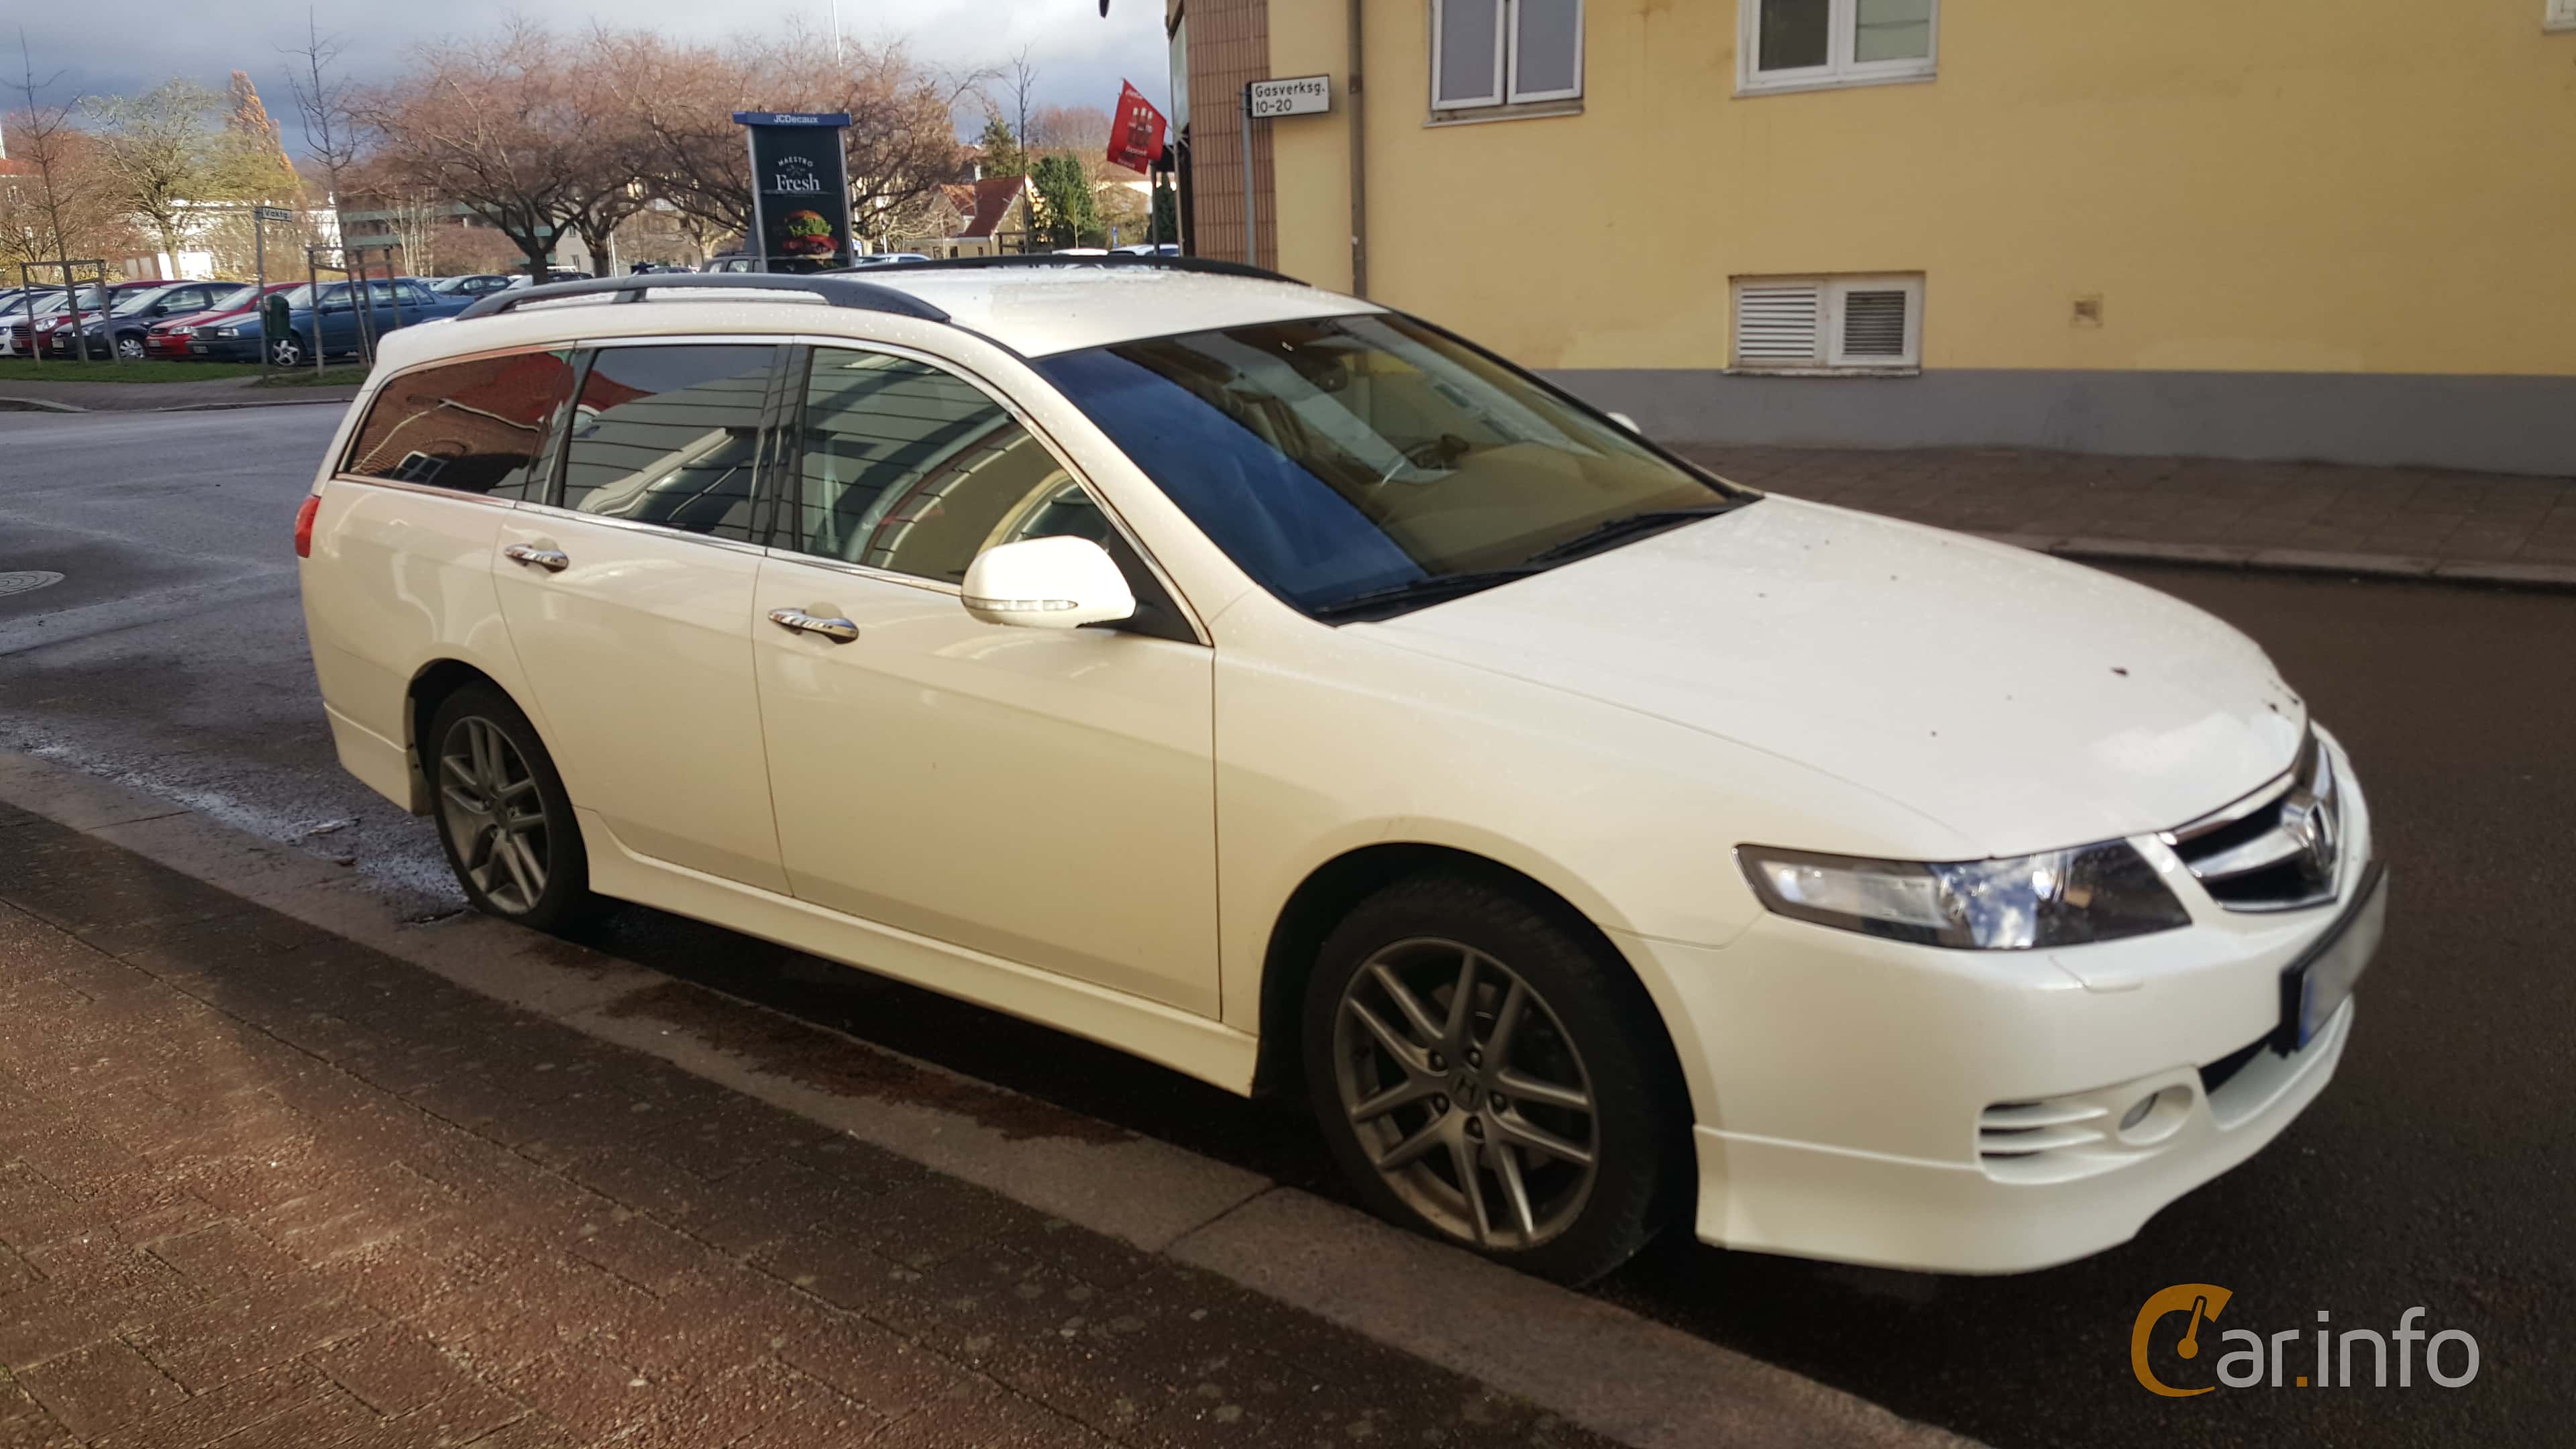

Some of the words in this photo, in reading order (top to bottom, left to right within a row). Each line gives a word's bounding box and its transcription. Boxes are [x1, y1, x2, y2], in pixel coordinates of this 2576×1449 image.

[1255, 82, 1326, 97] Gasverksg.
[1256, 99, 1292, 113] 10-20
[773, 114, 819, 123] JCDecaux
[778, 156, 814, 166] MAESTRO
[775, 173, 820, 191] Fresh
